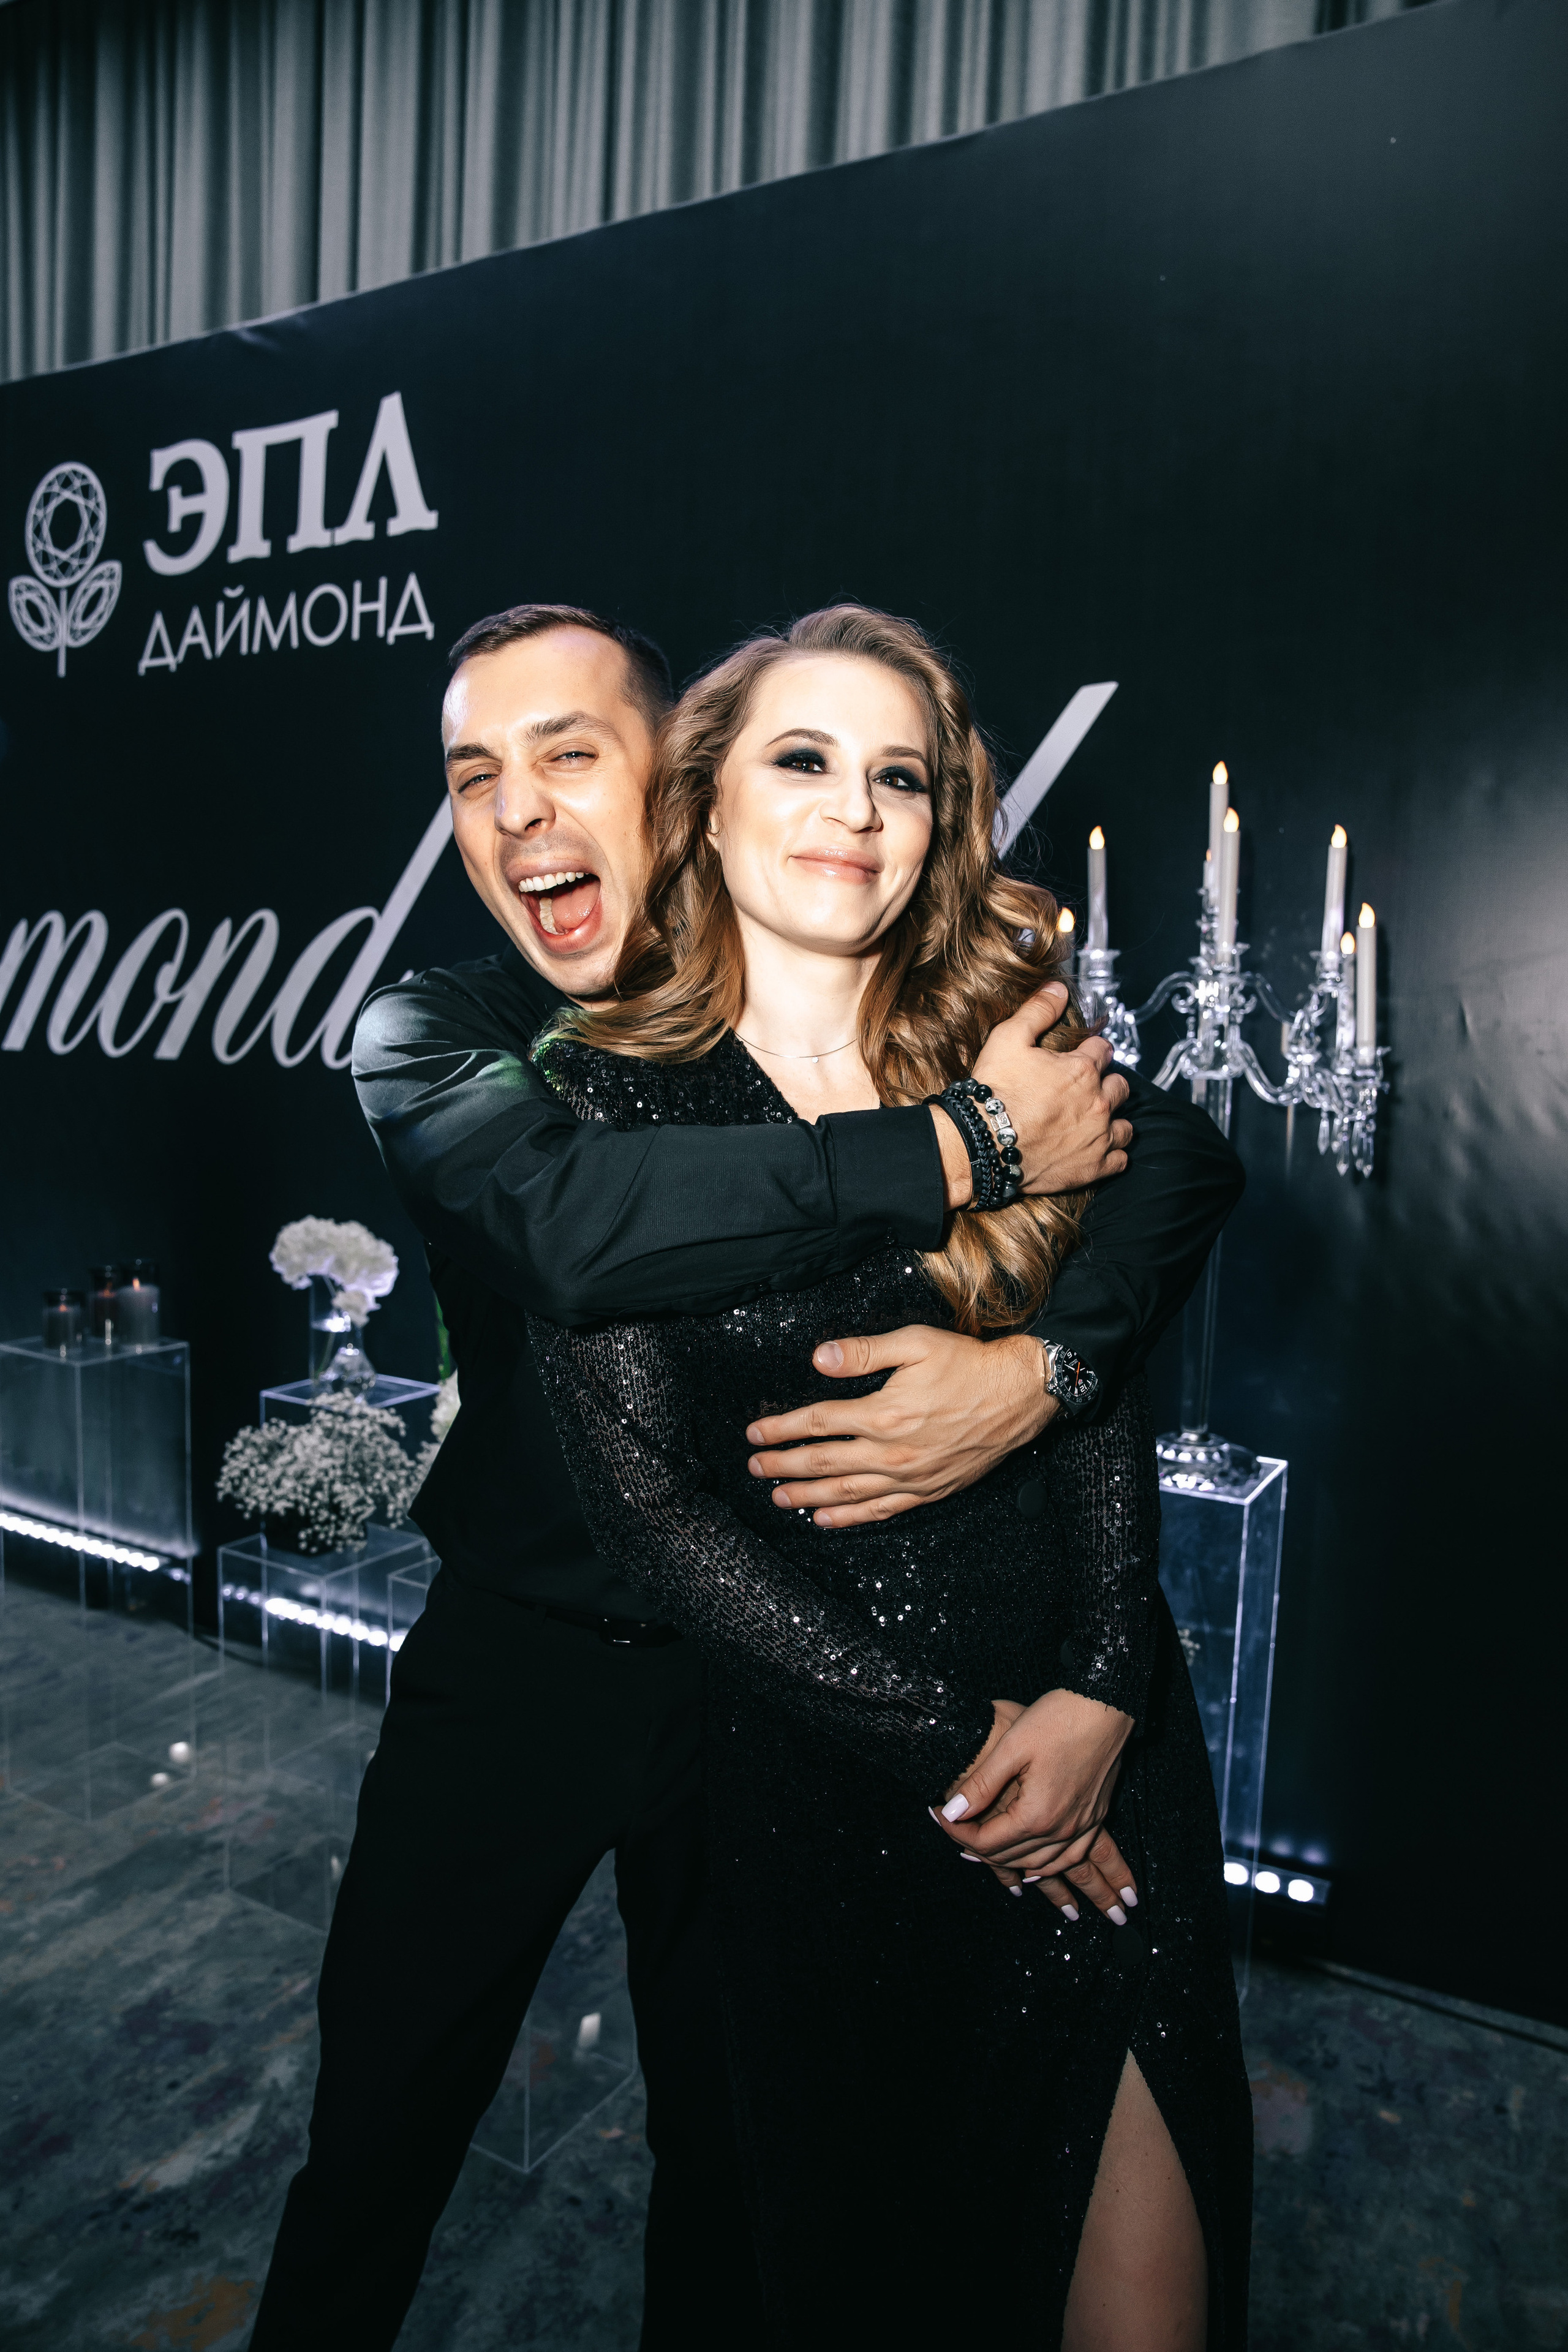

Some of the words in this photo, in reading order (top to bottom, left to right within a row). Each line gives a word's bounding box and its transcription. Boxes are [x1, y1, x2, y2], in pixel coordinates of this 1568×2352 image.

[143, 391, 438, 576] ЭПЛ
[138, 572, 435, 676] ДАЙМОНД
[1080, 1384, 1087, 1392] 12
